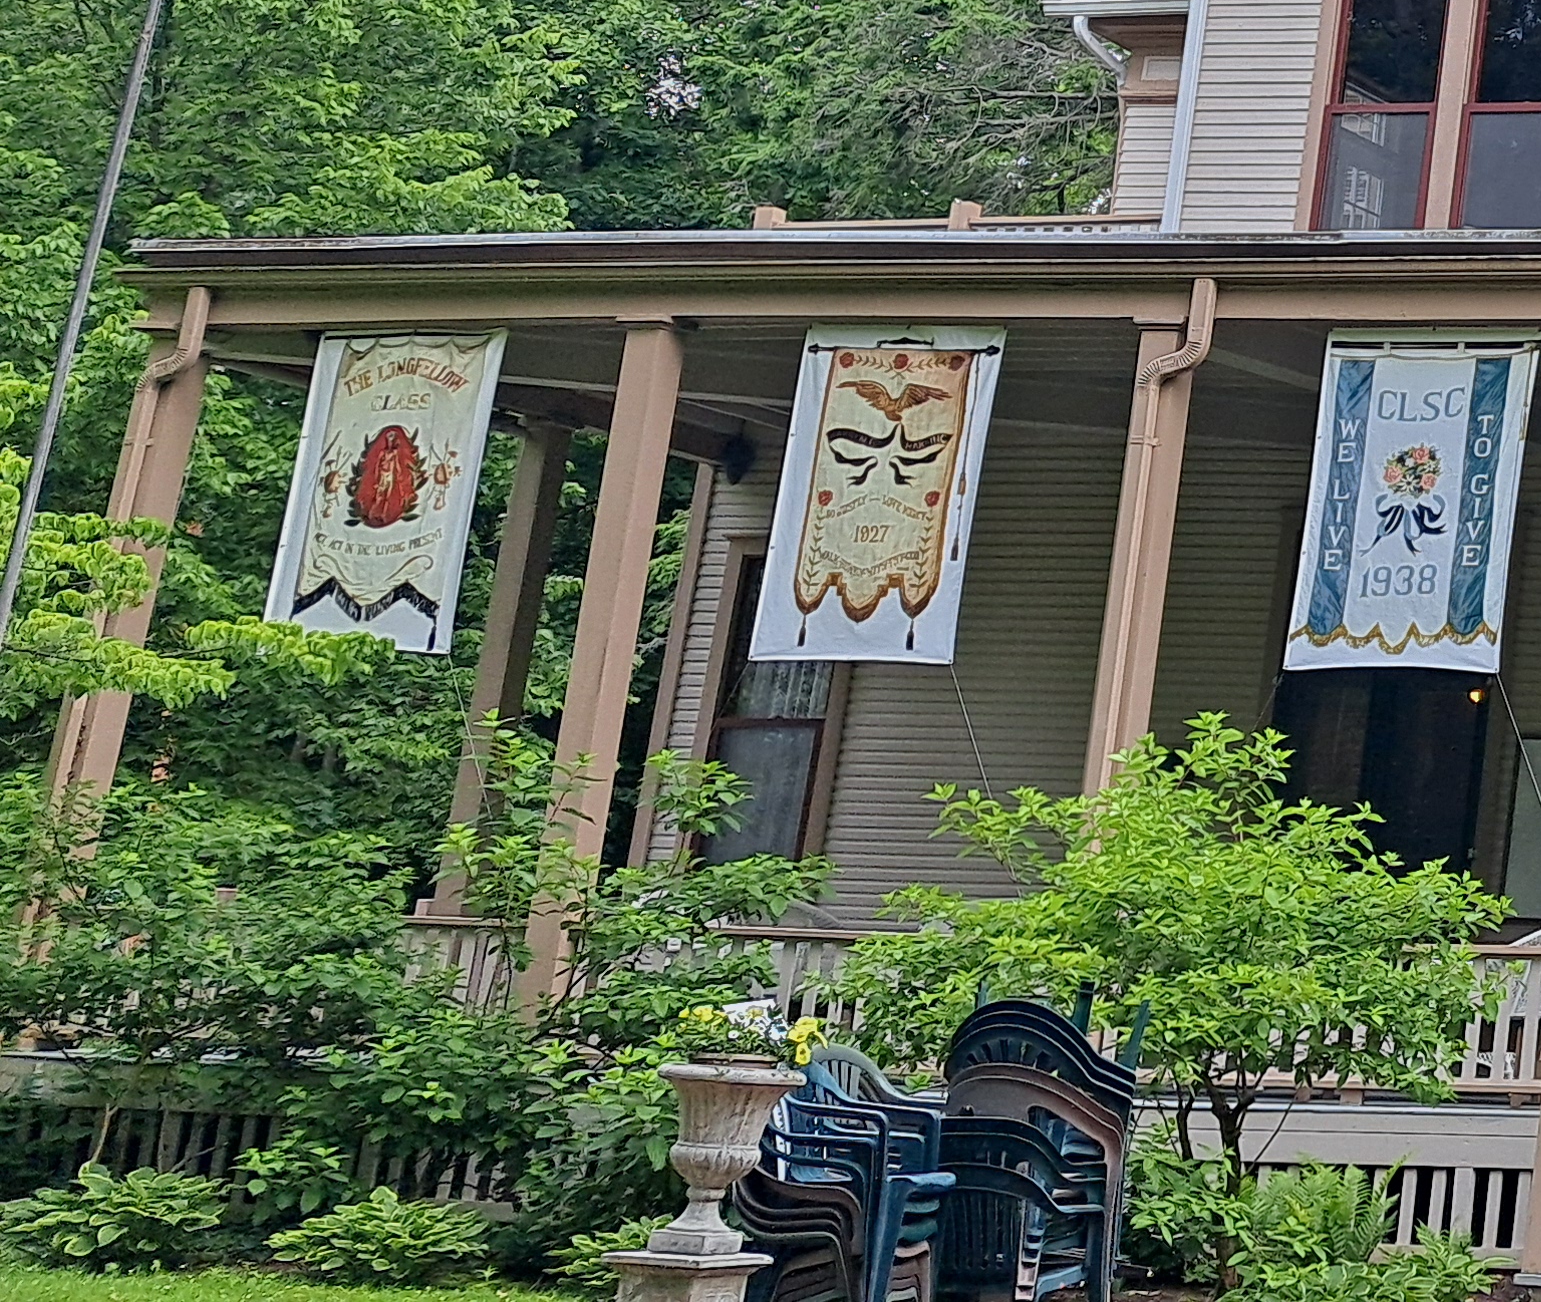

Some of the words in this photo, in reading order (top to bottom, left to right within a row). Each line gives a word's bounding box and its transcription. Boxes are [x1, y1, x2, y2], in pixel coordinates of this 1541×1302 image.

[343, 369, 373, 396] THE
[377, 357, 470, 393] LONGFELLOW
[371, 393, 431, 411] CLASS
[1378, 387, 1466, 422] CLSC
[1337, 419, 1360, 462] WE
[1474, 415, 1494, 458] TO
[853, 525, 892, 543] 1927
[1324, 479, 1350, 571] LIVE
[1461, 474, 1489, 566] GIVE
[1360, 564, 1438, 598] 1938
